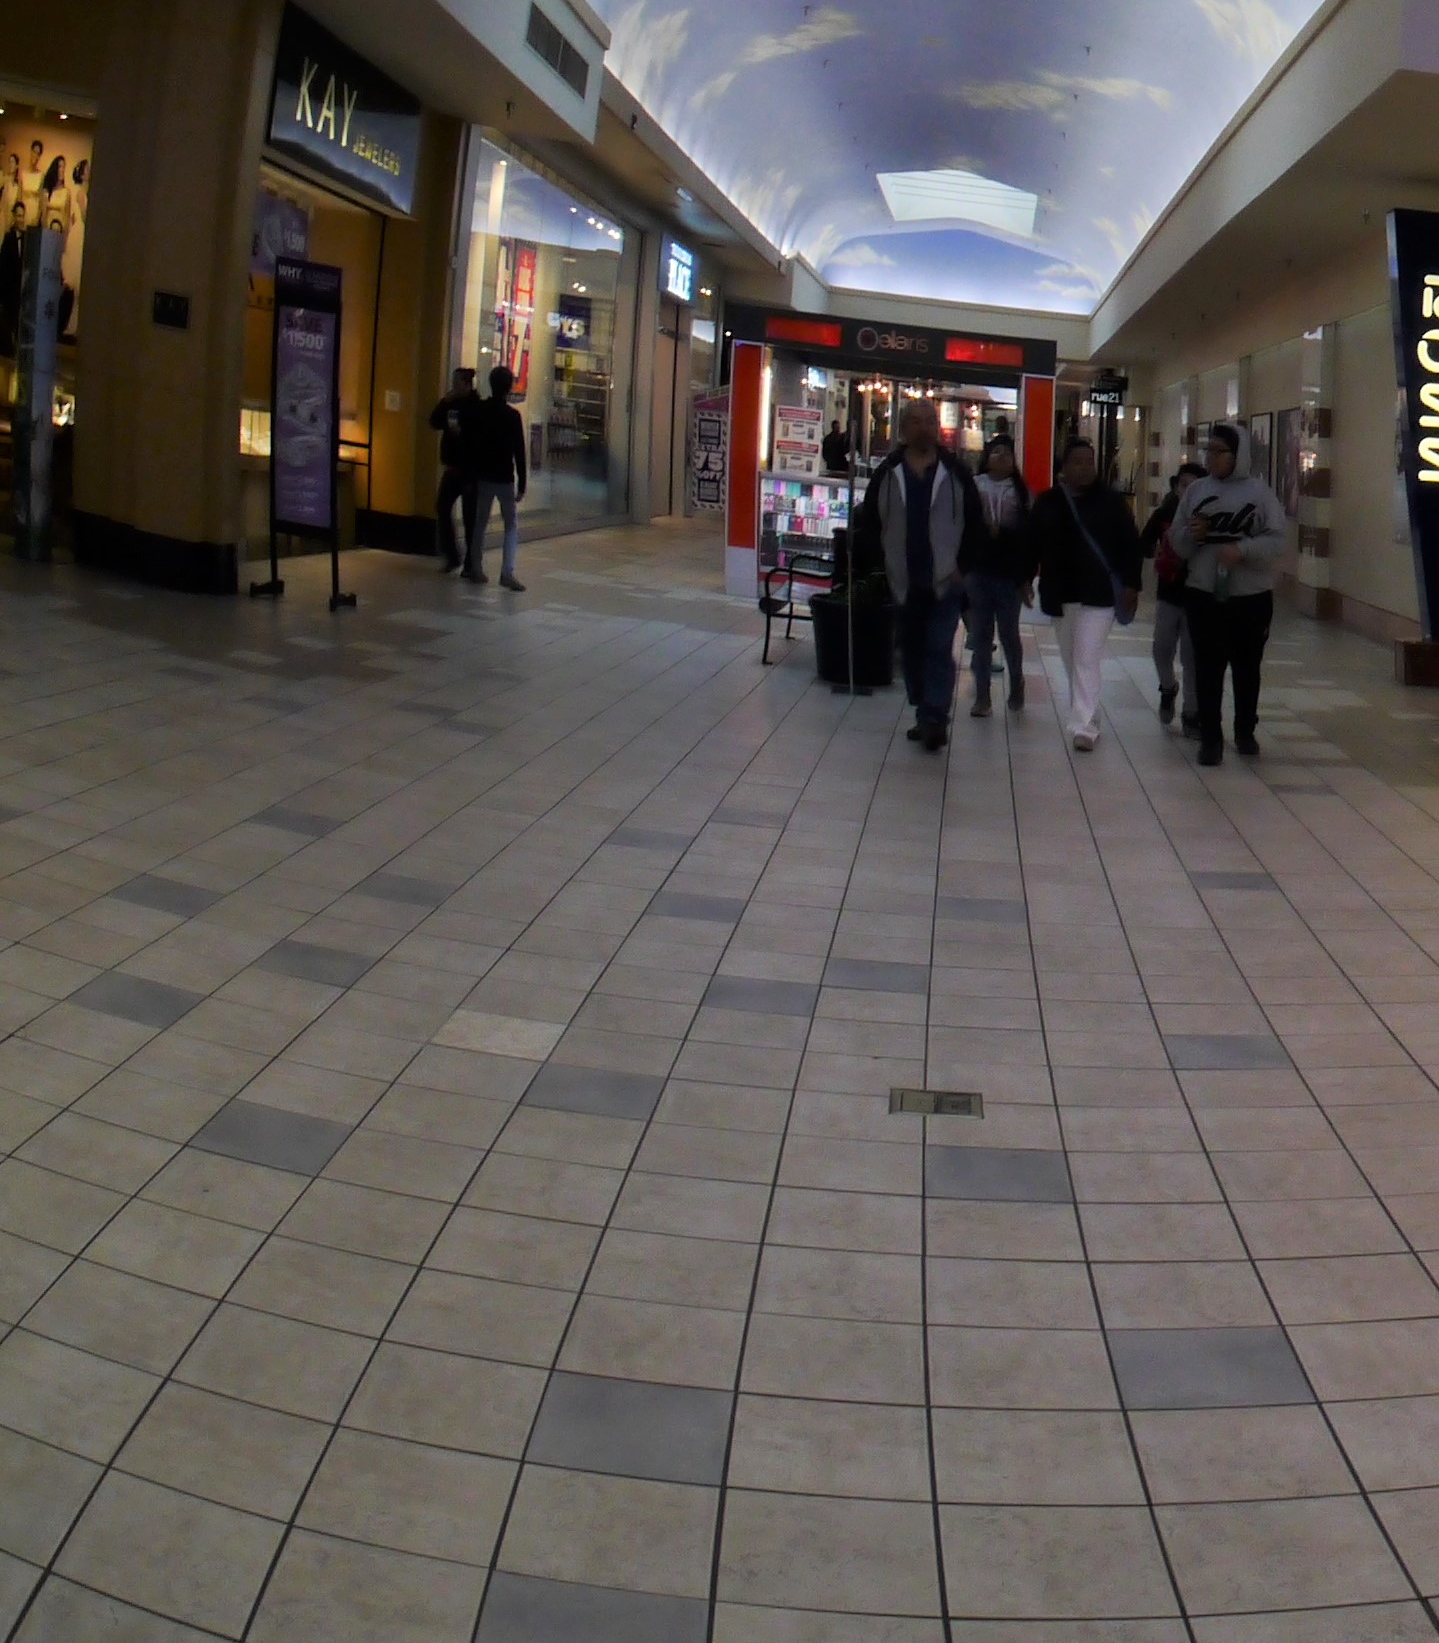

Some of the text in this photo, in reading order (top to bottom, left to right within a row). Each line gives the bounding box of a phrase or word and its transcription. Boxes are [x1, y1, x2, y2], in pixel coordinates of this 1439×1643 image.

[295, 57, 358, 147] KAY
[1091, 392, 1120, 403] rue21
[693, 449, 725, 472] 75
